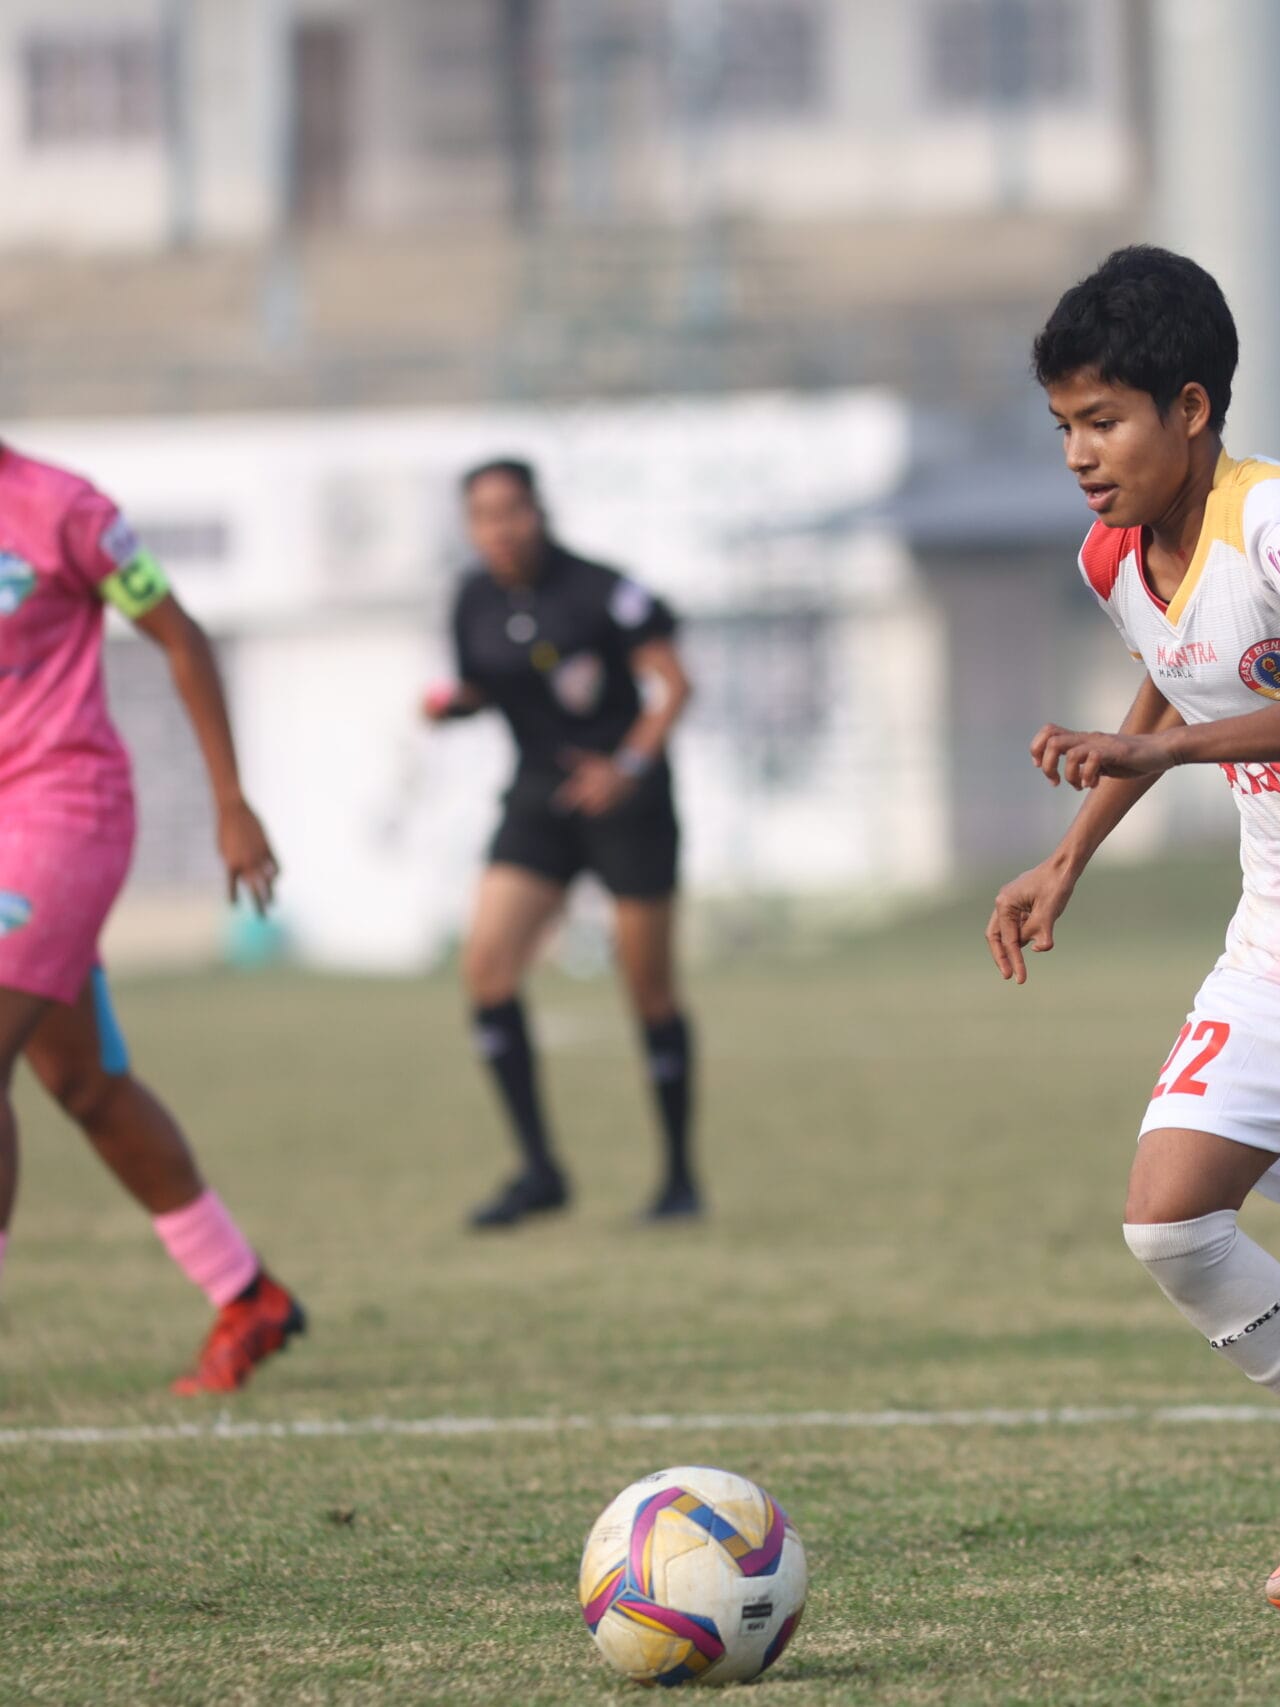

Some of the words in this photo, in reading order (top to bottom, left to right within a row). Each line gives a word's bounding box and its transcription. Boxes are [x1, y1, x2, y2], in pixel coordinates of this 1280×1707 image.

[119, 561, 156, 602] C
[1157, 638, 1218, 667] MANTRA
[1240, 652, 1255, 683] EAST
[1151, 1020, 1231, 1100] 22
